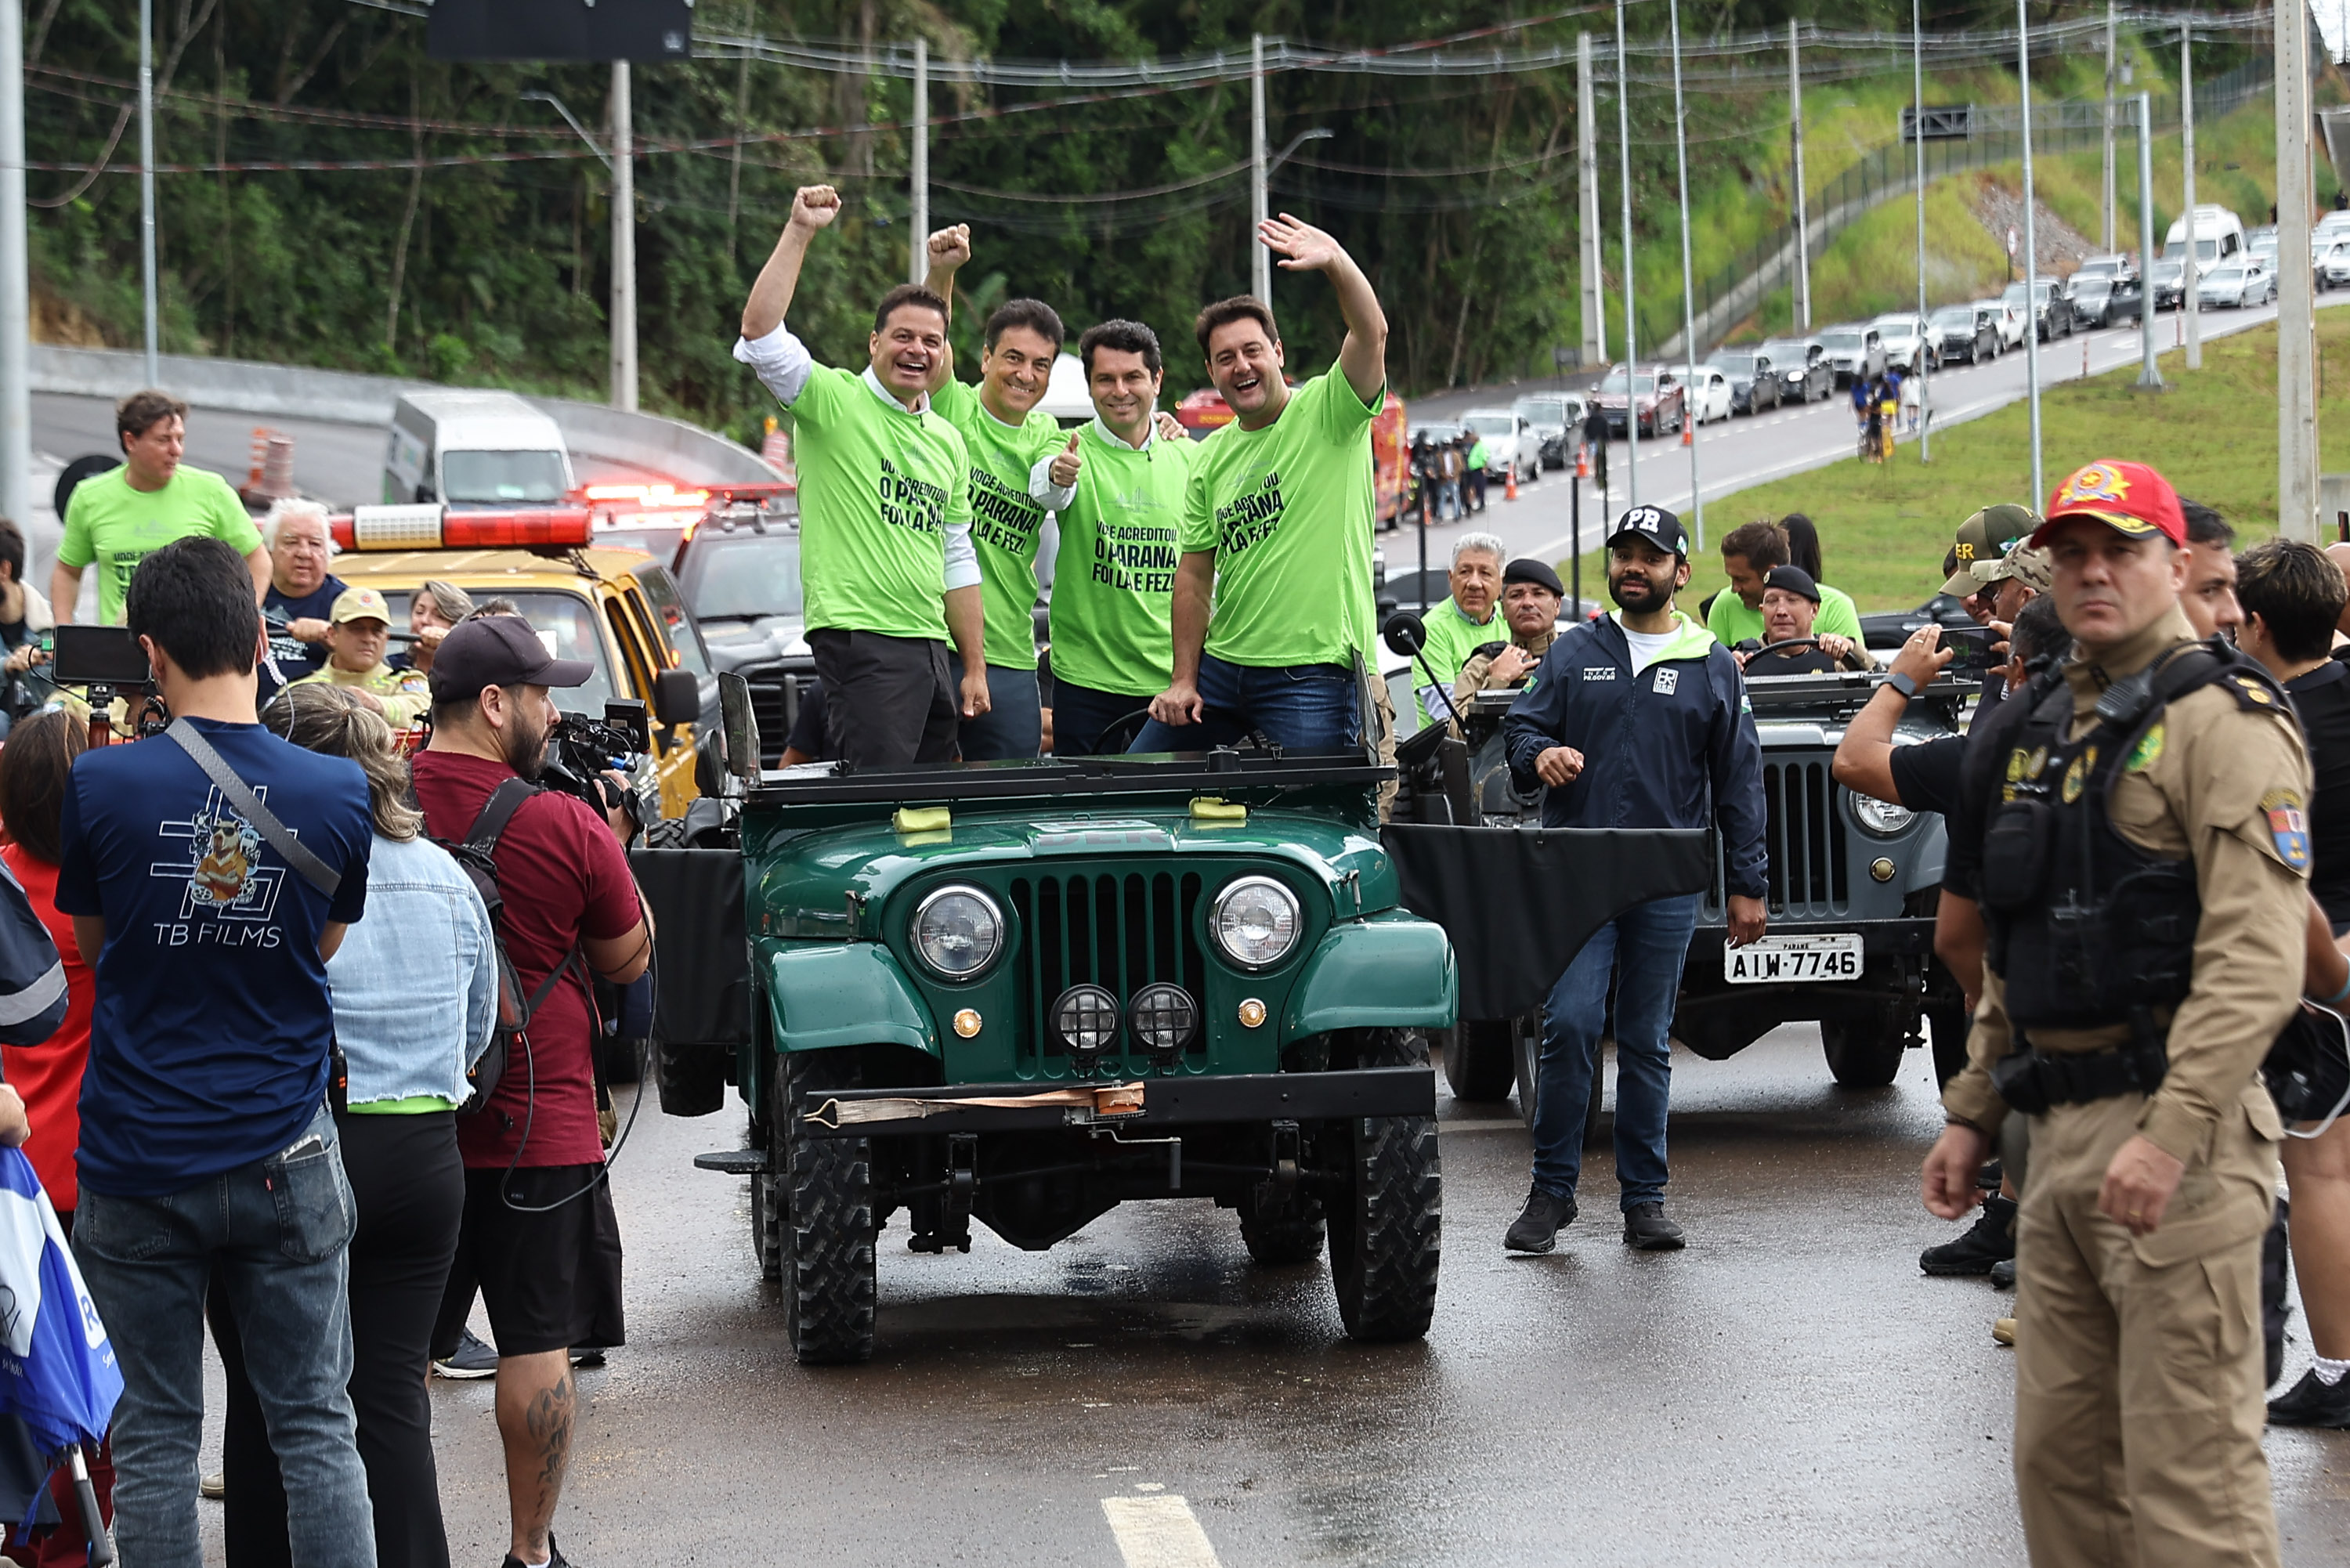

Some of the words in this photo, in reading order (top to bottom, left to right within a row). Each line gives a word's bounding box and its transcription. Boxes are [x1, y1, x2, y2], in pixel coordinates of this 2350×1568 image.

[880, 476, 891, 499] O
[971, 466, 997, 490] VOCÊ
[972, 489, 1039, 536] PARANÁ
[1624, 508, 1661, 533] PR
[989, 526, 1003, 545] E
[1000, 531, 1028, 556] FEZ!
[1095, 537, 1105, 560] O
[1092, 562, 1114, 587] FOI
[1134, 573, 1143, 592] E
[154, 923, 189, 946] TB
[197, 923, 282, 948] FILMS
